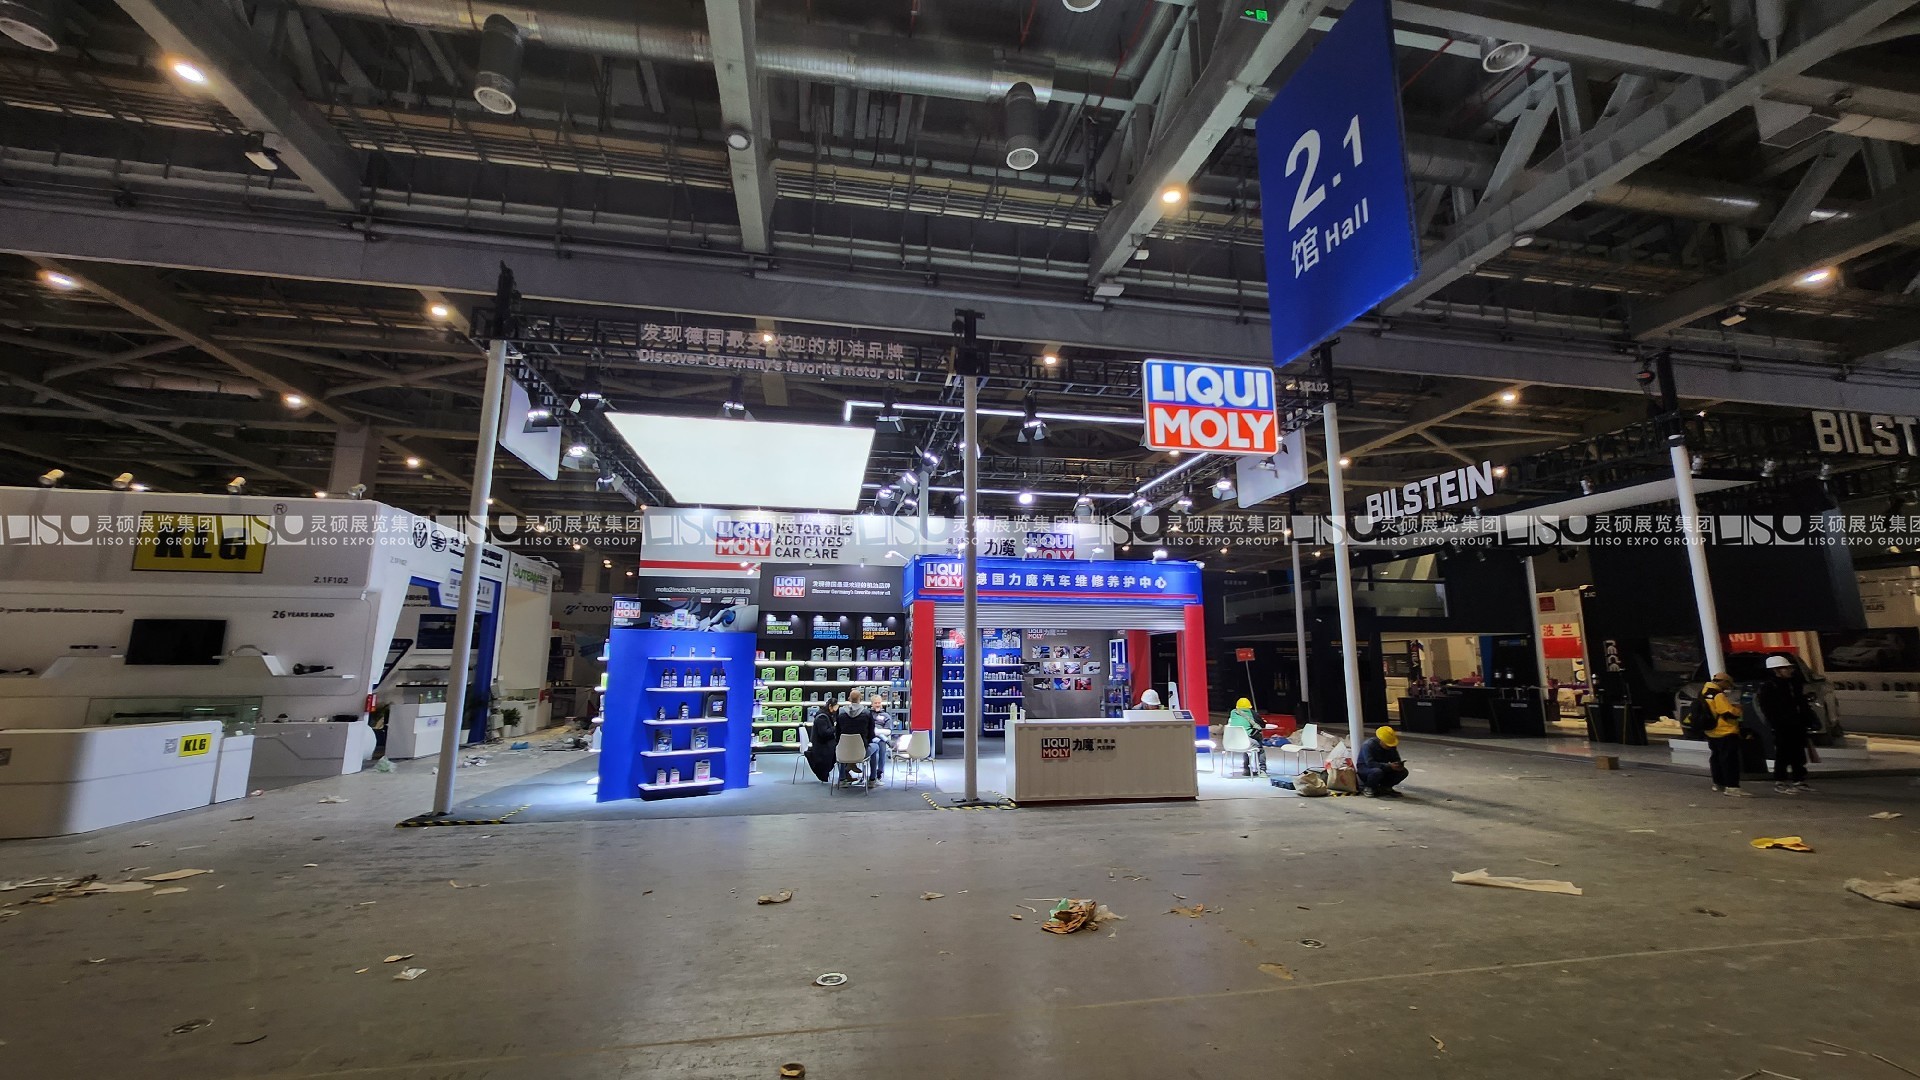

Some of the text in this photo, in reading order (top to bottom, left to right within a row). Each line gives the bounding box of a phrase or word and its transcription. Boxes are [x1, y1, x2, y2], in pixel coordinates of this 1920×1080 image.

[1285, 114, 1363, 232] 2.1
[1325, 197, 1369, 254] Hall
[1291, 226, 1320, 279] 馆
[638, 349, 904, 380] Discover Germany's favorite motor oil
[1151, 364, 1269, 408] LIQUI
[1154, 407, 1273, 449] MOLY
[1811, 410, 1920, 457] BILST
[1366, 460, 1495, 525] BILSTEIN
[719, 520, 771, 538] LIQUI
[776, 522, 853, 536] MOTOR OILS
[155, 522, 248, 560] KLG
[717, 538, 771, 555] MOLY
[775, 535, 842, 547] ADDITIVES
[984, 538, 1016, 557] 力魔
[1027, 533, 1074, 549] LIQUI
[775, 548, 838, 559] CAR CARE
[926, 563, 963, 576] LIQUI
[314, 576, 349, 584] 2.1F102
[776, 578, 804, 587] LIQUI
[926, 575, 963, 587] MOLY
[976, 572, 1168, 589] 德国力魔汽车维修养护中心
[776, 586, 804, 596] MOLY
[583, 605, 613, 613] TOYOT
[616, 601, 640, 610] LIQUI
[272, 610, 286, 619] 26
[615, 609, 640, 617] MOLY
[1543, 624, 1573, 637] 波兰
[183, 738, 207, 752] KLG
[1042, 738, 1069, 748] LIQUI
[1072, 738, 1095, 752] 力魔
[1042, 748, 1070, 758] MOLY
